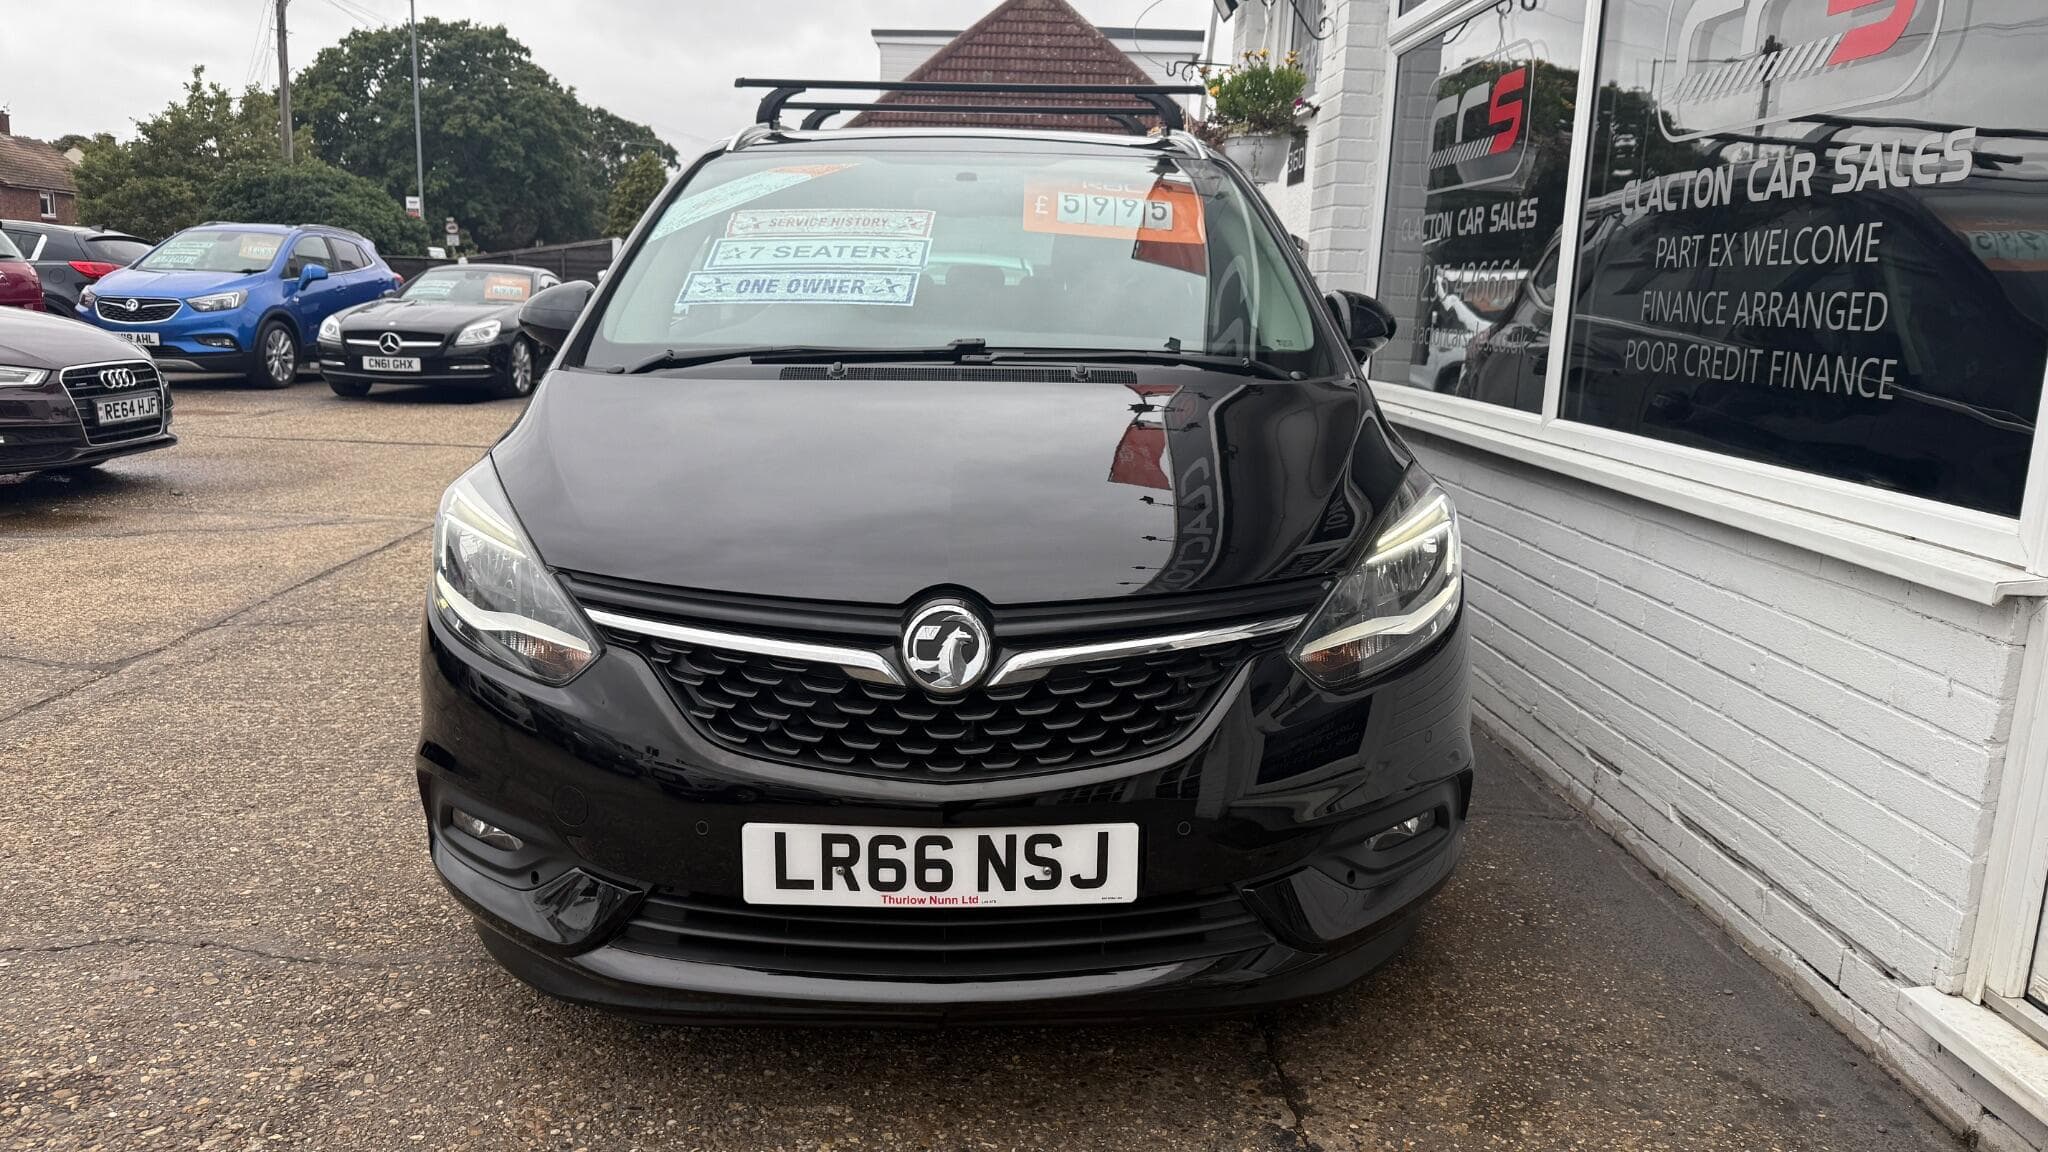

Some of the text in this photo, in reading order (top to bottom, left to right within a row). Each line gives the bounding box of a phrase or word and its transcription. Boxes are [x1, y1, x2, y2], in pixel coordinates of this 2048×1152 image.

[1621, 127, 1977, 216] CLACTON CAR SALES
[768, 216, 889, 228] SERVICE HISTORY
[1401, 197, 1539, 241] CLACTON CAR SALES
[750, 245, 890, 259] 7 SEATER
[1655, 221, 1884, 269] PART EX WELCOME
[736, 278, 866, 294] ONE OWNER
[1641, 290, 1889, 332] FINANCE ARRANGED
[136, 333, 155, 344] AHL
[368, 358, 414, 369] CN61 GHX
[1625, 339, 1898, 400] POOR CREDIT FINANCE
[104, 397, 156, 420] RE64 HJF
[774, 831, 1110, 893] LR66 NSJ
[881, 894, 928, 905] Thurlow
[929, 895, 959, 905] Nunn
[962, 894, 979, 904] Ltd
